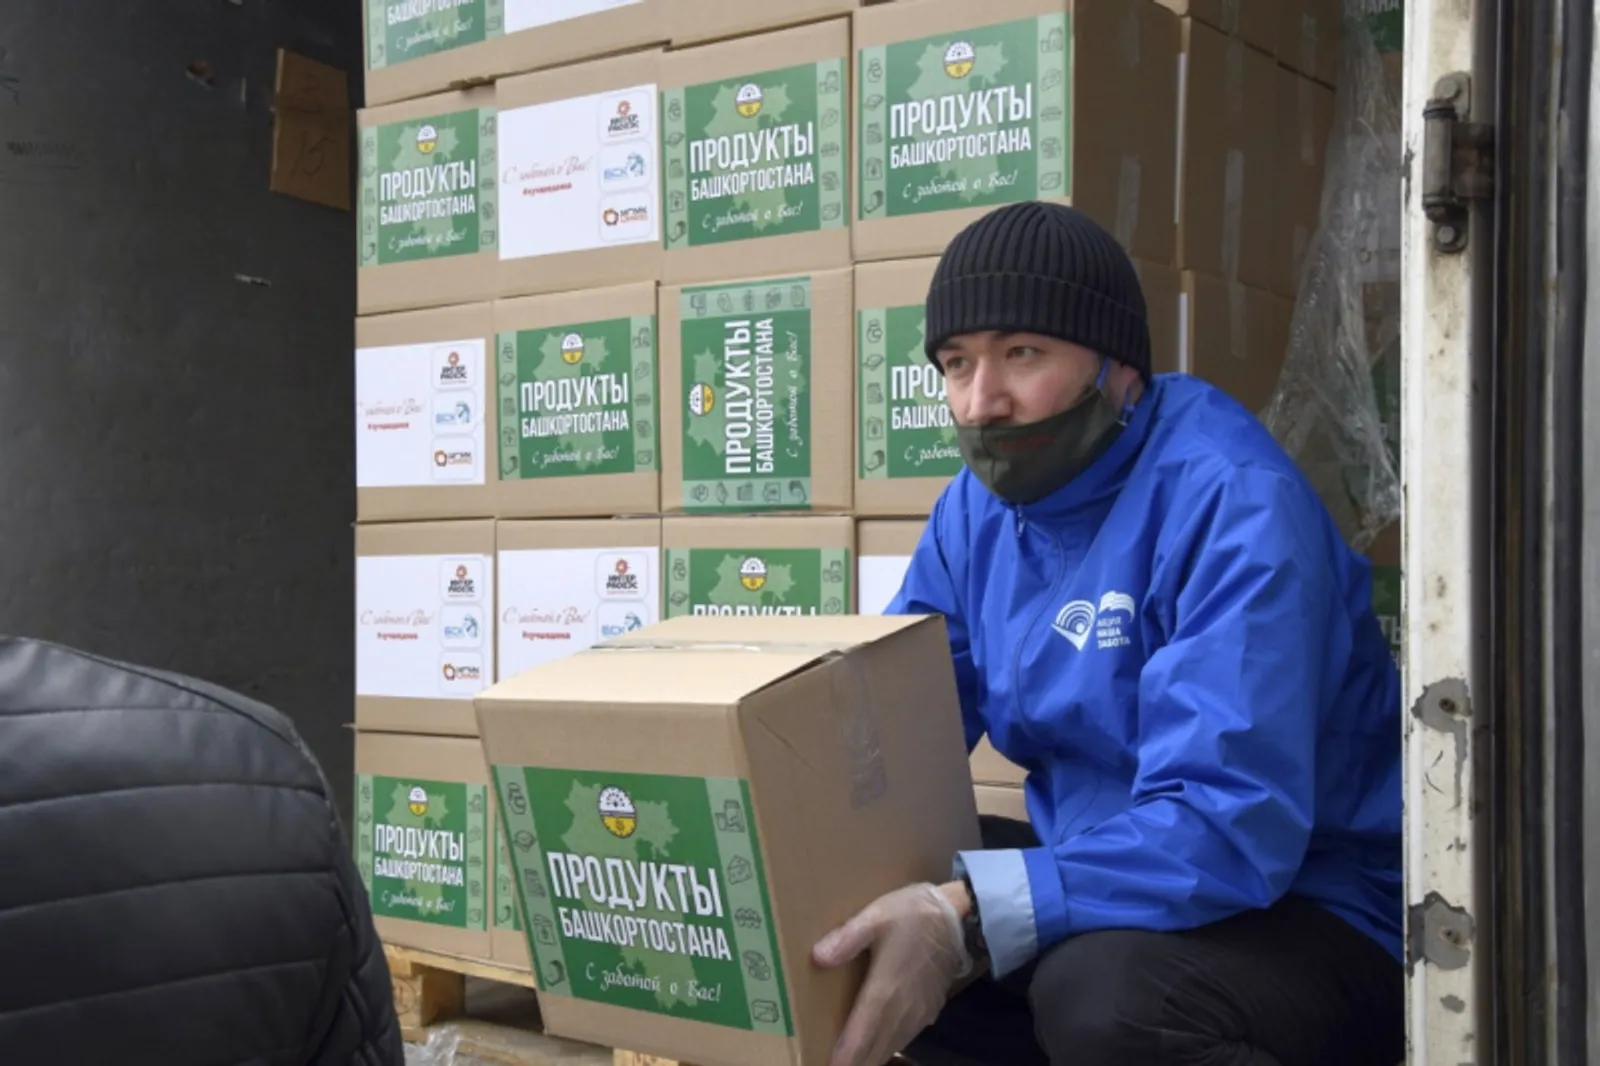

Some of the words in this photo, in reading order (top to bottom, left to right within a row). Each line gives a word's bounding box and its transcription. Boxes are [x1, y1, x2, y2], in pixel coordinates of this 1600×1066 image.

[388, 0, 474, 26] БАШКОРТО
[890, 83, 1032, 139] ПРОДУКТЫ
[690, 121, 813, 173] ПРОДУКТЫ
[890, 126, 1032, 169] БАШКОРТОСТАНА
[380, 158, 476, 201] ПРОДУКТЫ
[691, 161, 814, 201] БАШКОРТОСТАНА
[902, 182, 912, 198] С
[912, 175, 967, 203] заботой
[973, 178, 981, 190] о
[988, 169, 1018, 188] Вас!
[380, 193, 475, 225] БАШКОРТОСТАНА
[520, 373, 629, 412] ПРОДУКТЫ
[724, 320, 751, 473] ПРОДУКТЫ
[756, 318, 774, 473] БАШКОРТОСТАНА
[522, 409, 629, 438] БАШКОРТОСТАНА
[374, 824, 464, 862] ПРОДУКТЫ
[374, 857, 464, 887] БАШКОРТОСТАНА
[546, 851, 723, 917] ПРОДУКТЫ
[558, 907, 733, 961] БАШКОРТОСТАНА
[585, 962, 595, 981] С
[600, 962, 661, 991] заботой
[670, 982, 677, 995] о
[688, 980, 721, 1002] Вас!
